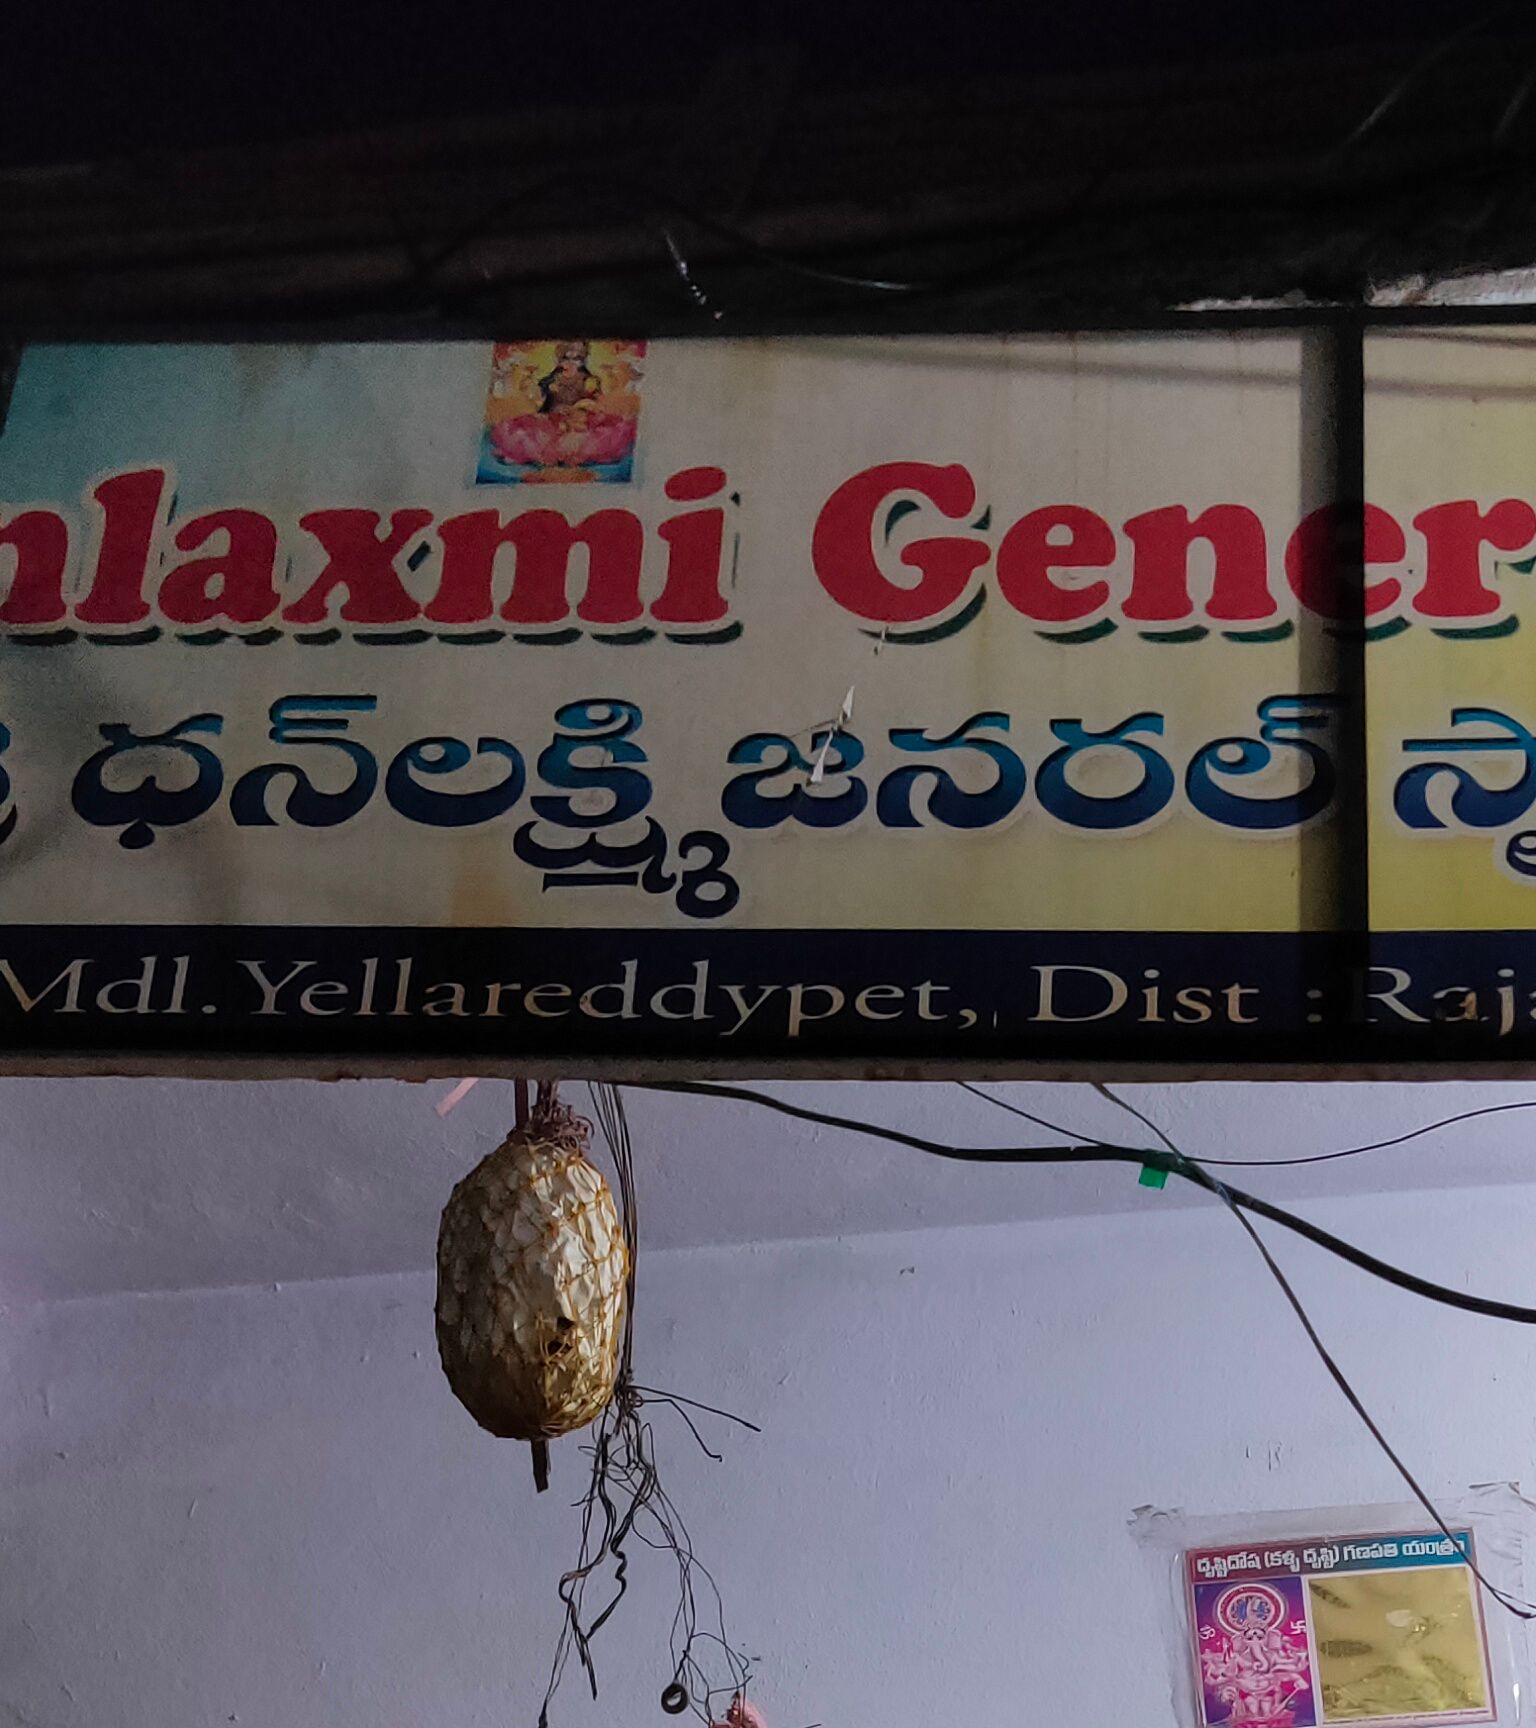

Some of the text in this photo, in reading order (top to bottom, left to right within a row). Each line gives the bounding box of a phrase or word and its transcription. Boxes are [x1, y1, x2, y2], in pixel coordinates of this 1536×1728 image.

[720, 690, 1336, 834] జనరల్
[236, 956, 980, 1038] Yellareddypet,
[1027, 963, 1260, 1024] Dist
